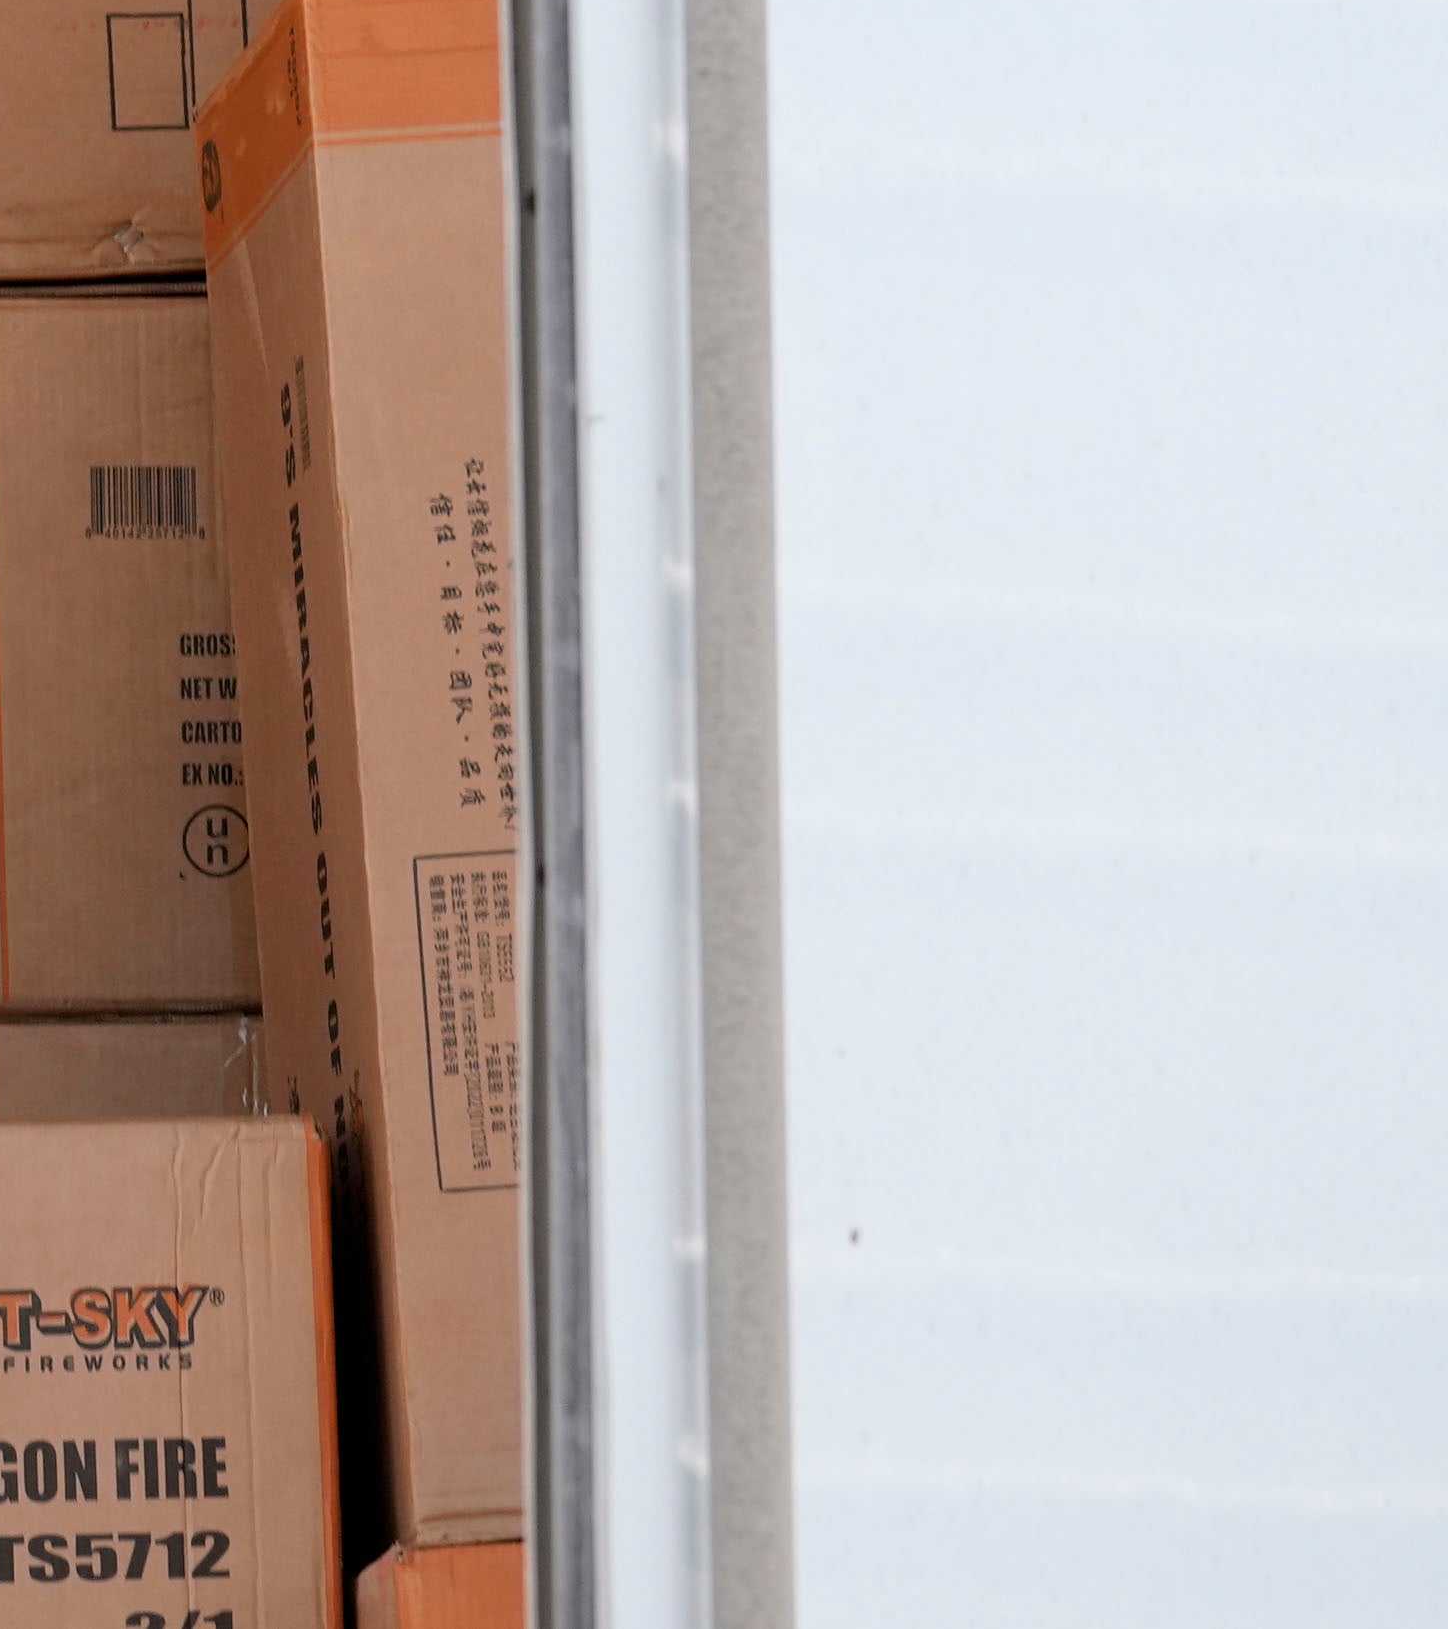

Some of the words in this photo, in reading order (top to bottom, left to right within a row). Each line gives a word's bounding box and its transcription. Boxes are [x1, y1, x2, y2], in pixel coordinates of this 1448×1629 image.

[181, 678, 212, 699] NET
[182, 721, 241, 743] CARTO
[183, 763, 202, 785] EX
[1, 1354, 195, 1372] FIREWORKS
[115, 1436, 229, 1499] FIRE
